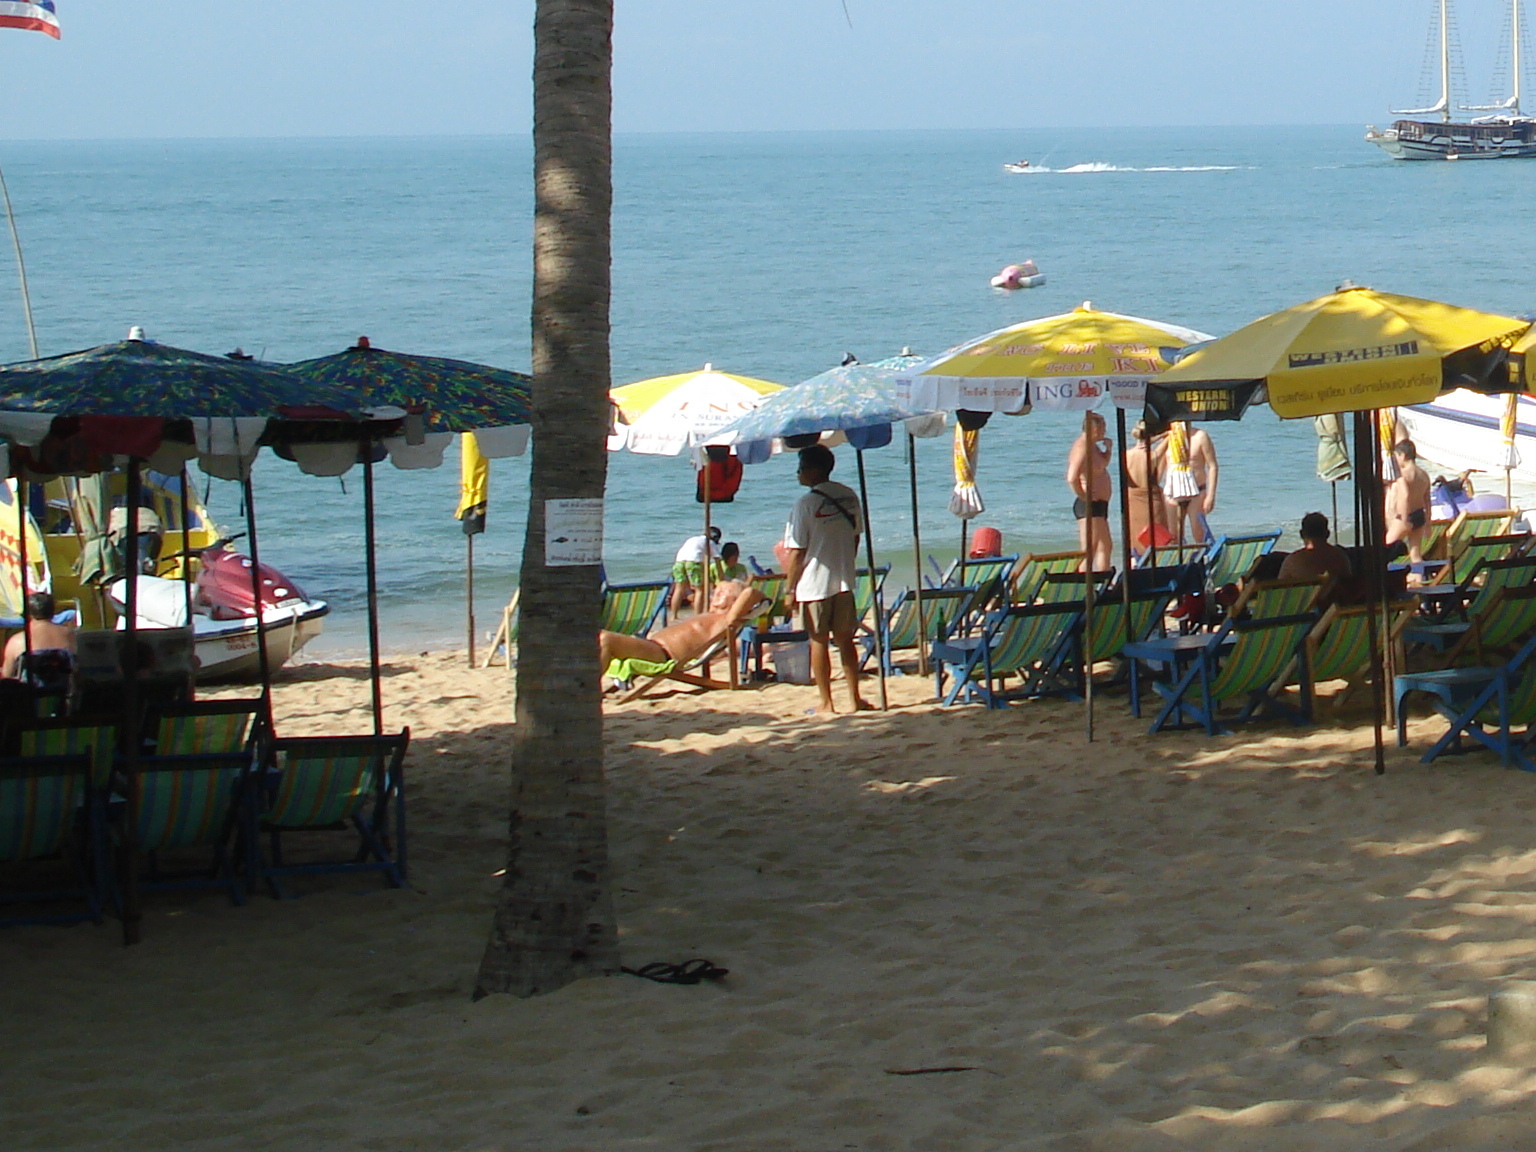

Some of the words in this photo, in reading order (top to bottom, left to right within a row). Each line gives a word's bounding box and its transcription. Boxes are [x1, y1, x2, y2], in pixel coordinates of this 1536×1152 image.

[1109, 357, 1164, 373] KI
[1036, 383, 1073, 401] ING
[1176, 389, 1230, 402] WESTERN
[1191, 401, 1230, 412] UNION
